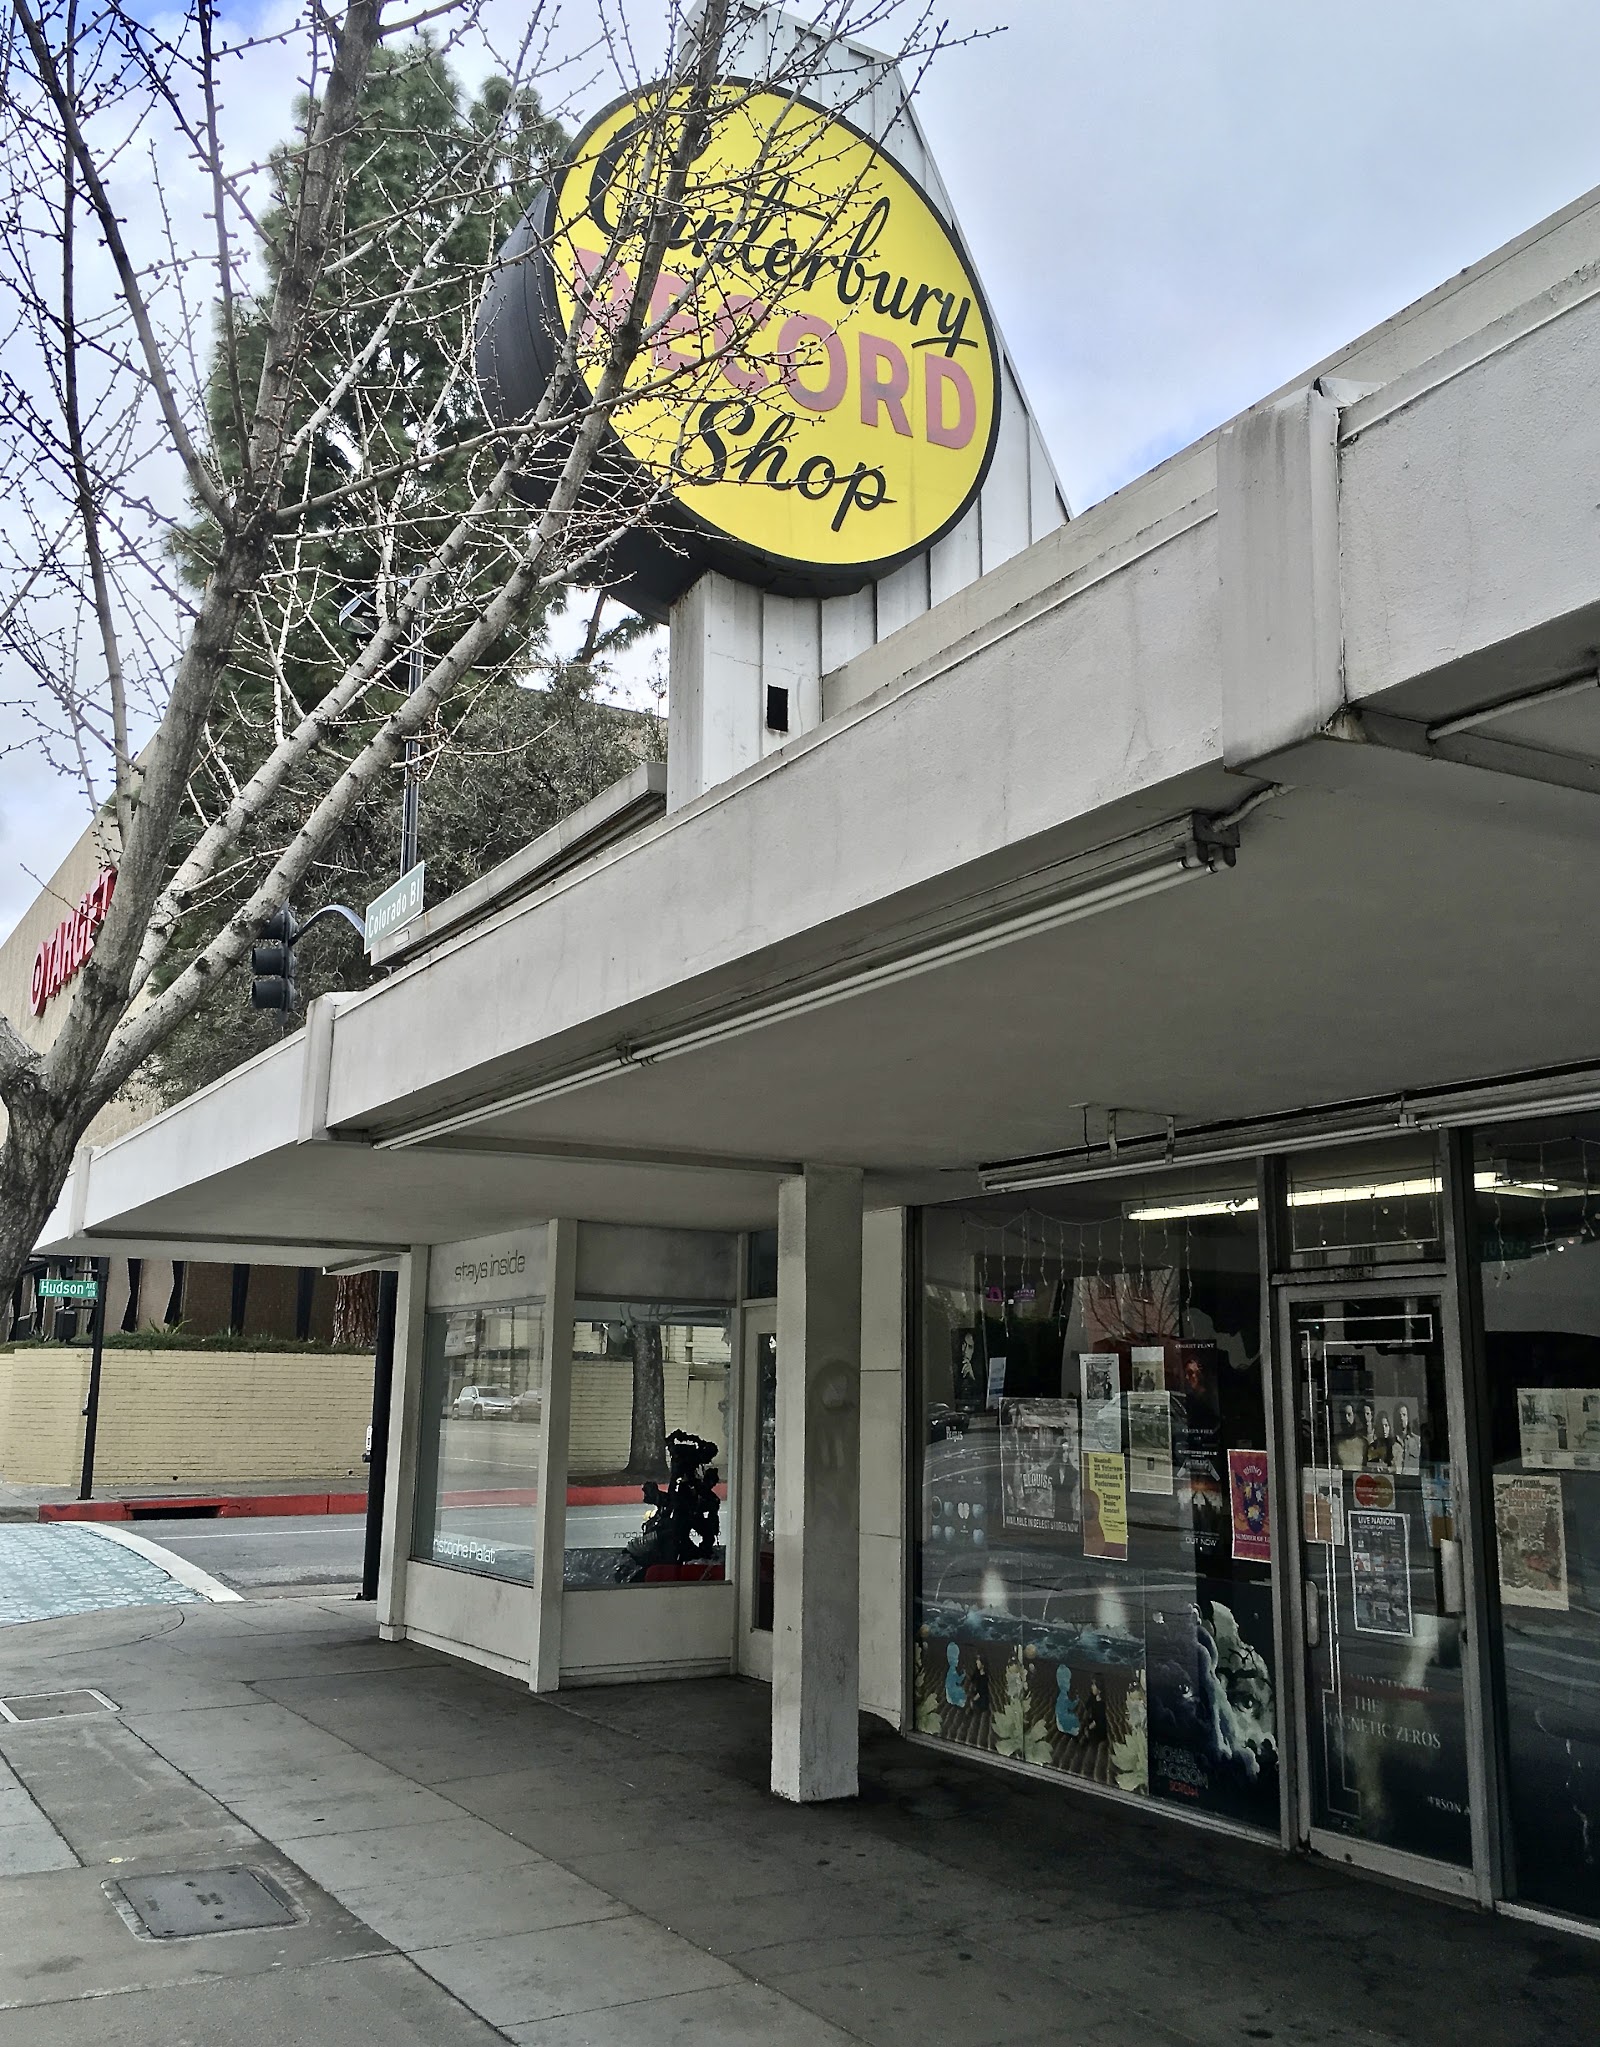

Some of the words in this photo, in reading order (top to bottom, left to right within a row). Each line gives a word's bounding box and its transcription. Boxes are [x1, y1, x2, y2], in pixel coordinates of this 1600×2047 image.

[670, 399, 896, 532] Shop
[368, 892, 407, 939] Colorado
[410, 877, 420, 907] Bl
[454, 1261, 488, 1285] stays
[489, 1249, 526, 1277] inside
[41, 1281, 84, 1295] Hudson
[1243, 1465, 1263, 1477] RHINO
[1033, 1518, 1050, 1530] SELECT
[1358, 1516, 1370, 1525] LIVE
[1371, 1516, 1396, 1526] NATION
[1185, 1536, 1198, 1545] OUT
[1200, 1537, 1217, 1547] NOW
[1396, 1726, 1441, 1750] ZEROS
